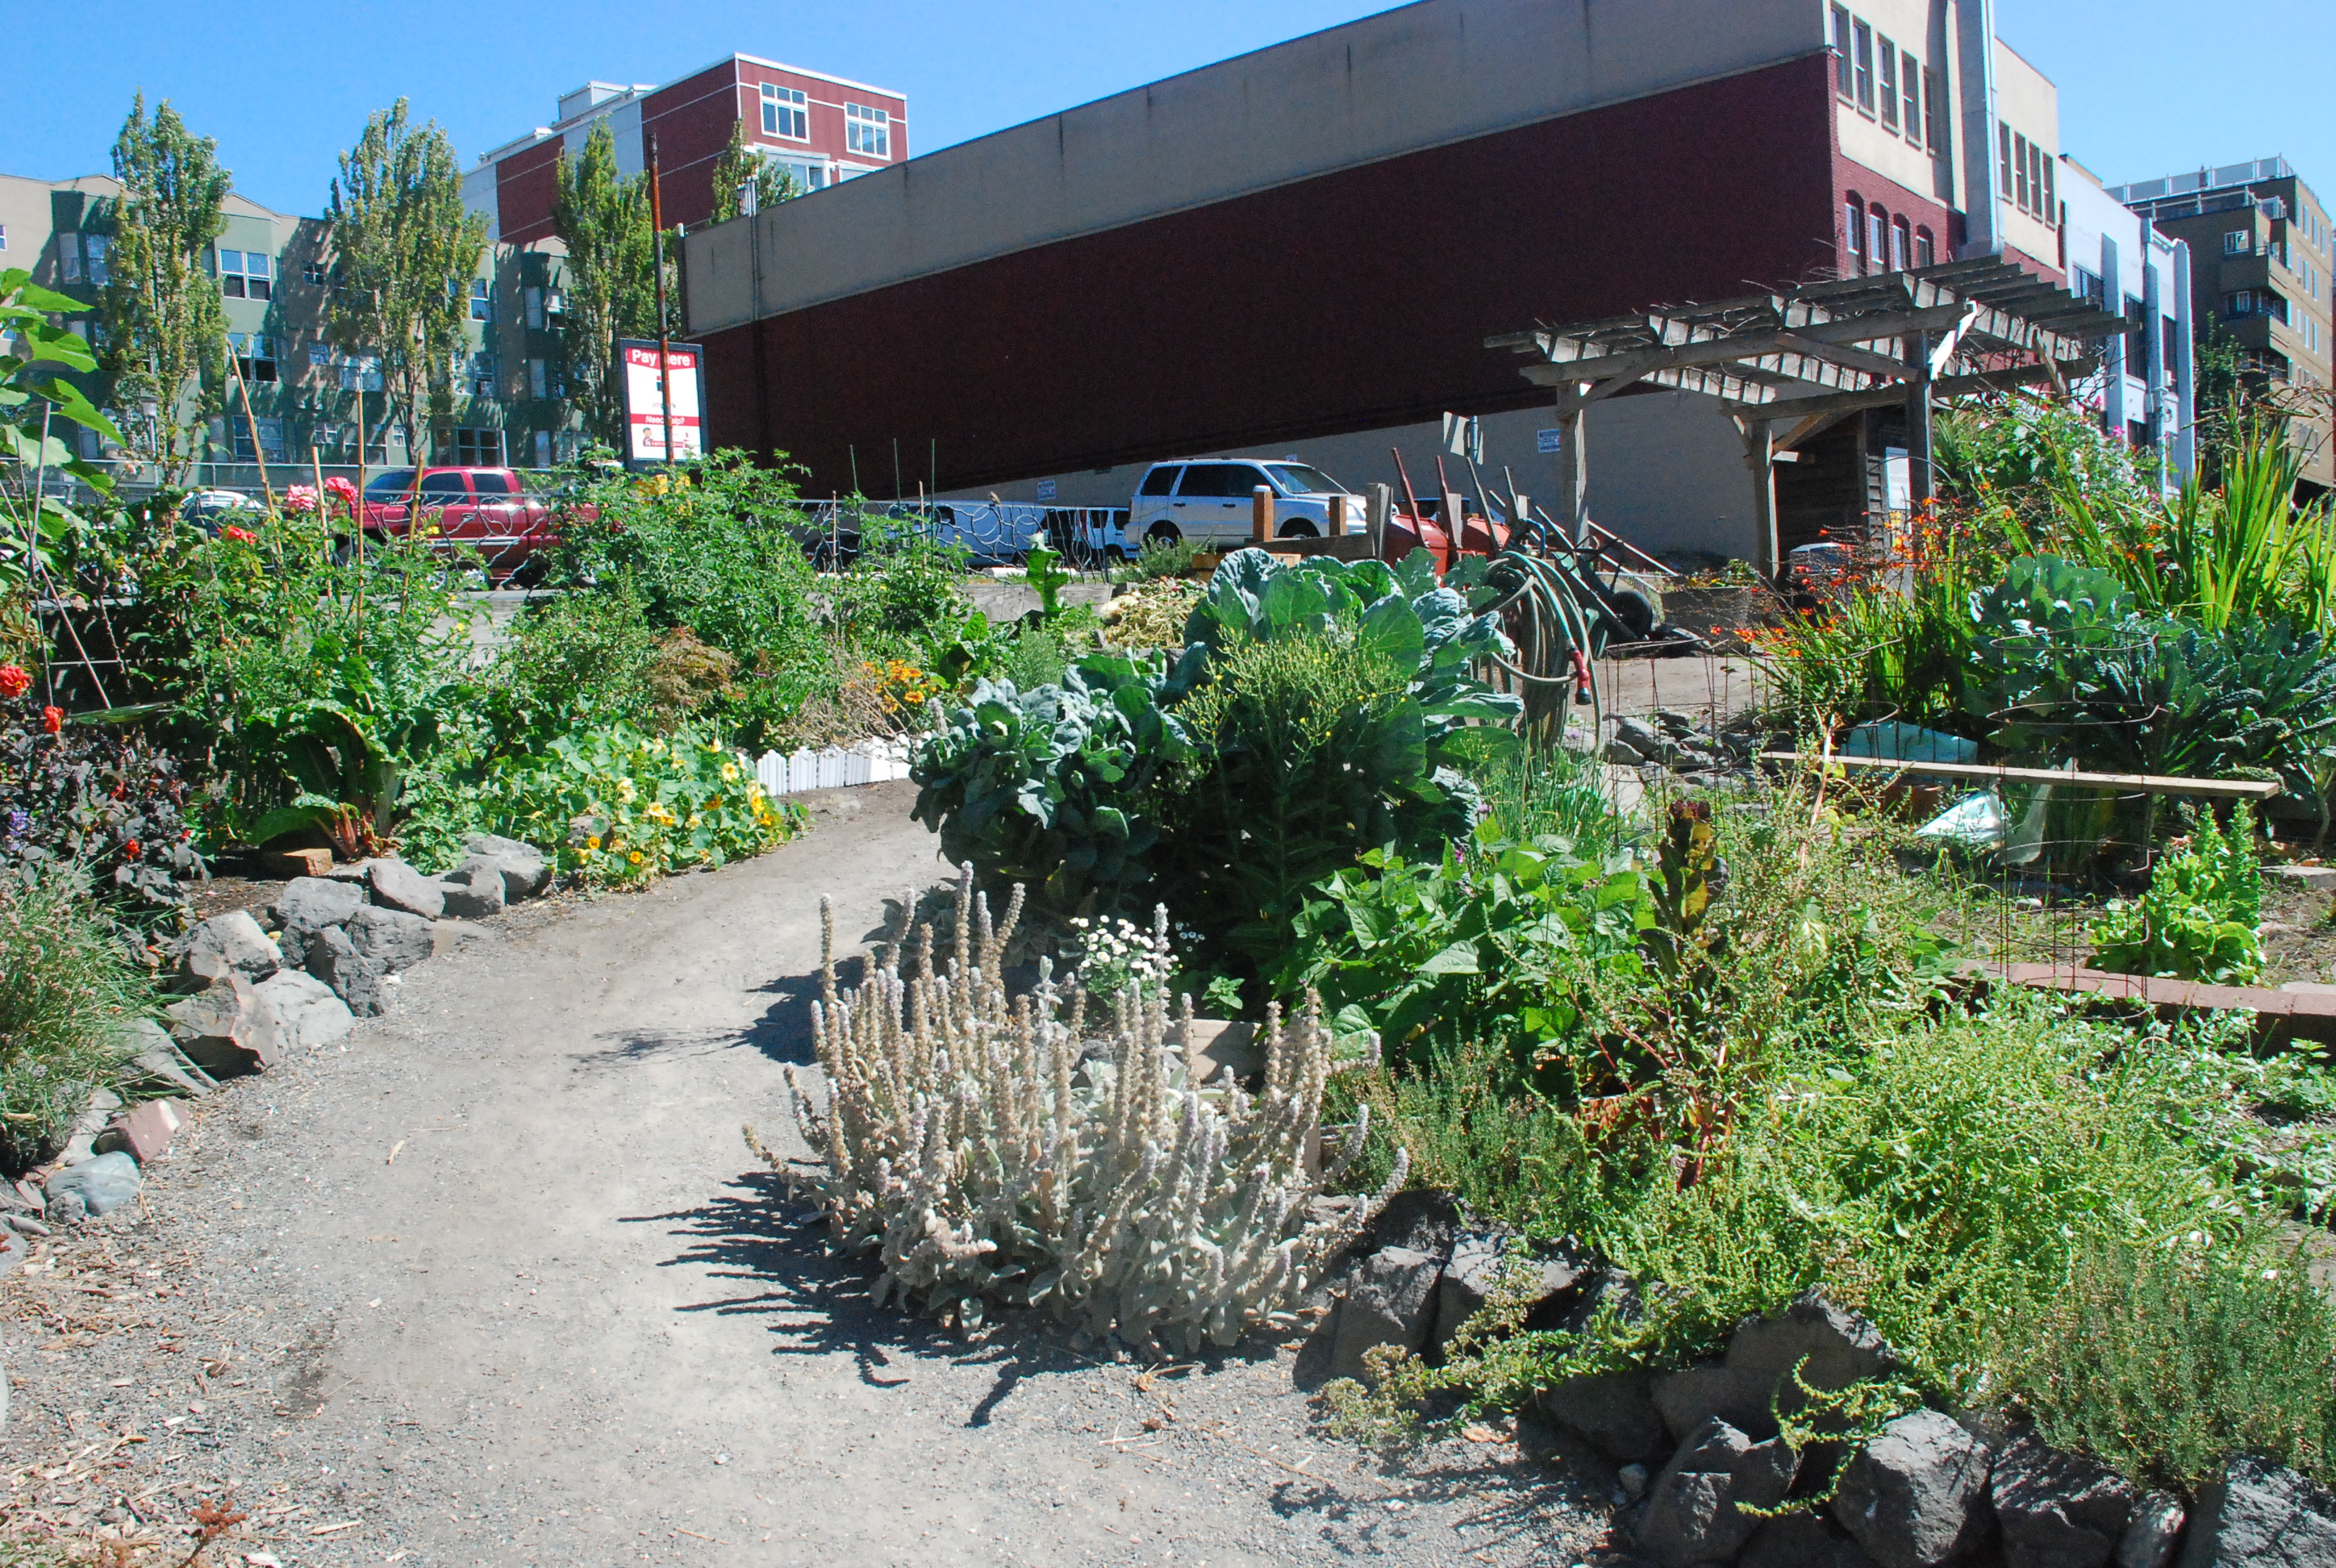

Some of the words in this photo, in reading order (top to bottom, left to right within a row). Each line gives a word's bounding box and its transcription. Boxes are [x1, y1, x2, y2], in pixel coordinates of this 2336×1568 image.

[632, 348, 657, 367] Pay
[667, 353, 691, 367] ere
[671, 417, 686, 426] elp?
